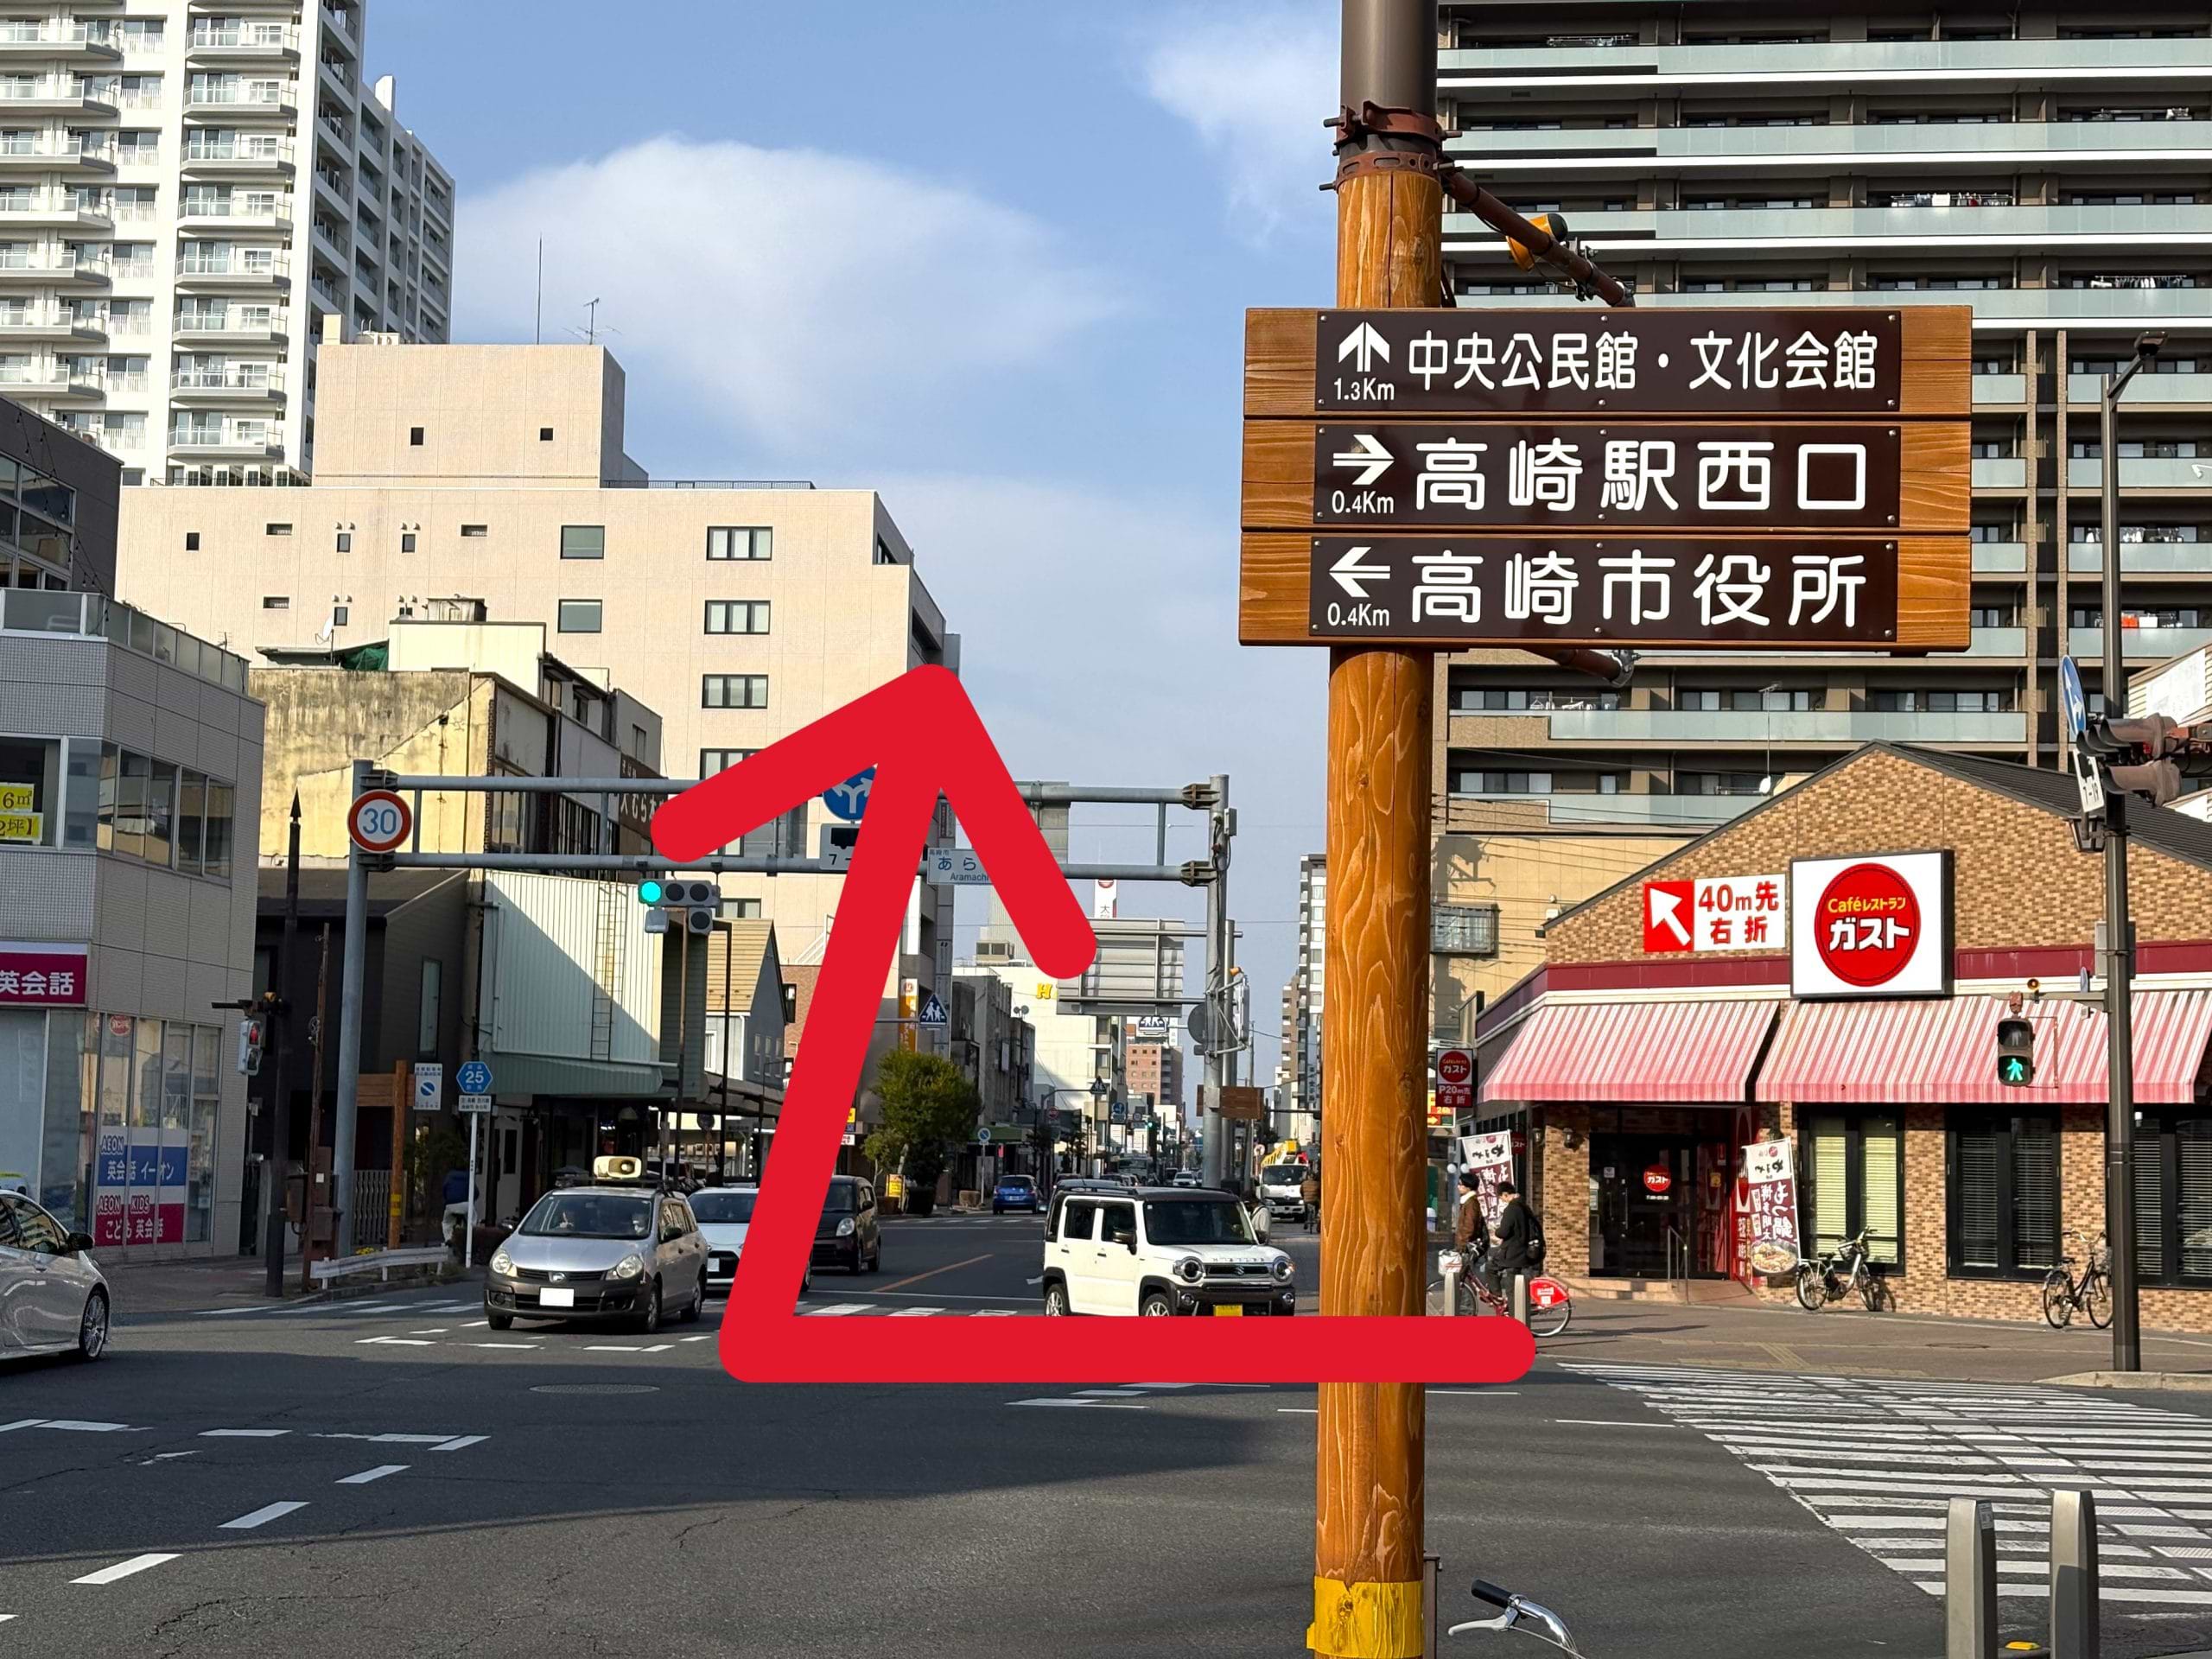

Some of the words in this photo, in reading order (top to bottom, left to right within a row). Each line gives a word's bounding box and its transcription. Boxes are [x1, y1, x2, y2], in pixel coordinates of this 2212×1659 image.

[1408, 329, 1878, 391] 中央公民館・文化会館
[1333, 377, 1395, 401] 1.3Km
[1415, 436, 1868, 512] 高崎駅西口
[1332, 490, 1395, 515] 0.4Km
[1411, 549, 1868, 628] 高崎市役所
[1327, 603, 1390, 628] 0.4Km
[363, 808, 397, 835] 30
[938, 856, 976, 871] あら
[1698, 880, 1779, 913] 40m先
[1827, 896, 1906, 913] Caféレストラン
[1709, 915, 1769, 944] 右折
[1828, 917, 1910, 951] ガスト
[0, 969, 74, 996] 英会話
[465, 1071, 484, 1084] 25
[1444, 1065, 1467, 1073] ガスト
[101, 1135, 124, 1153] AEON
[1647, 1175, 1669, 1184] ガスト
[98, 1194, 121, 1213] AEON
[130, 1194, 150, 1212] KIDS
